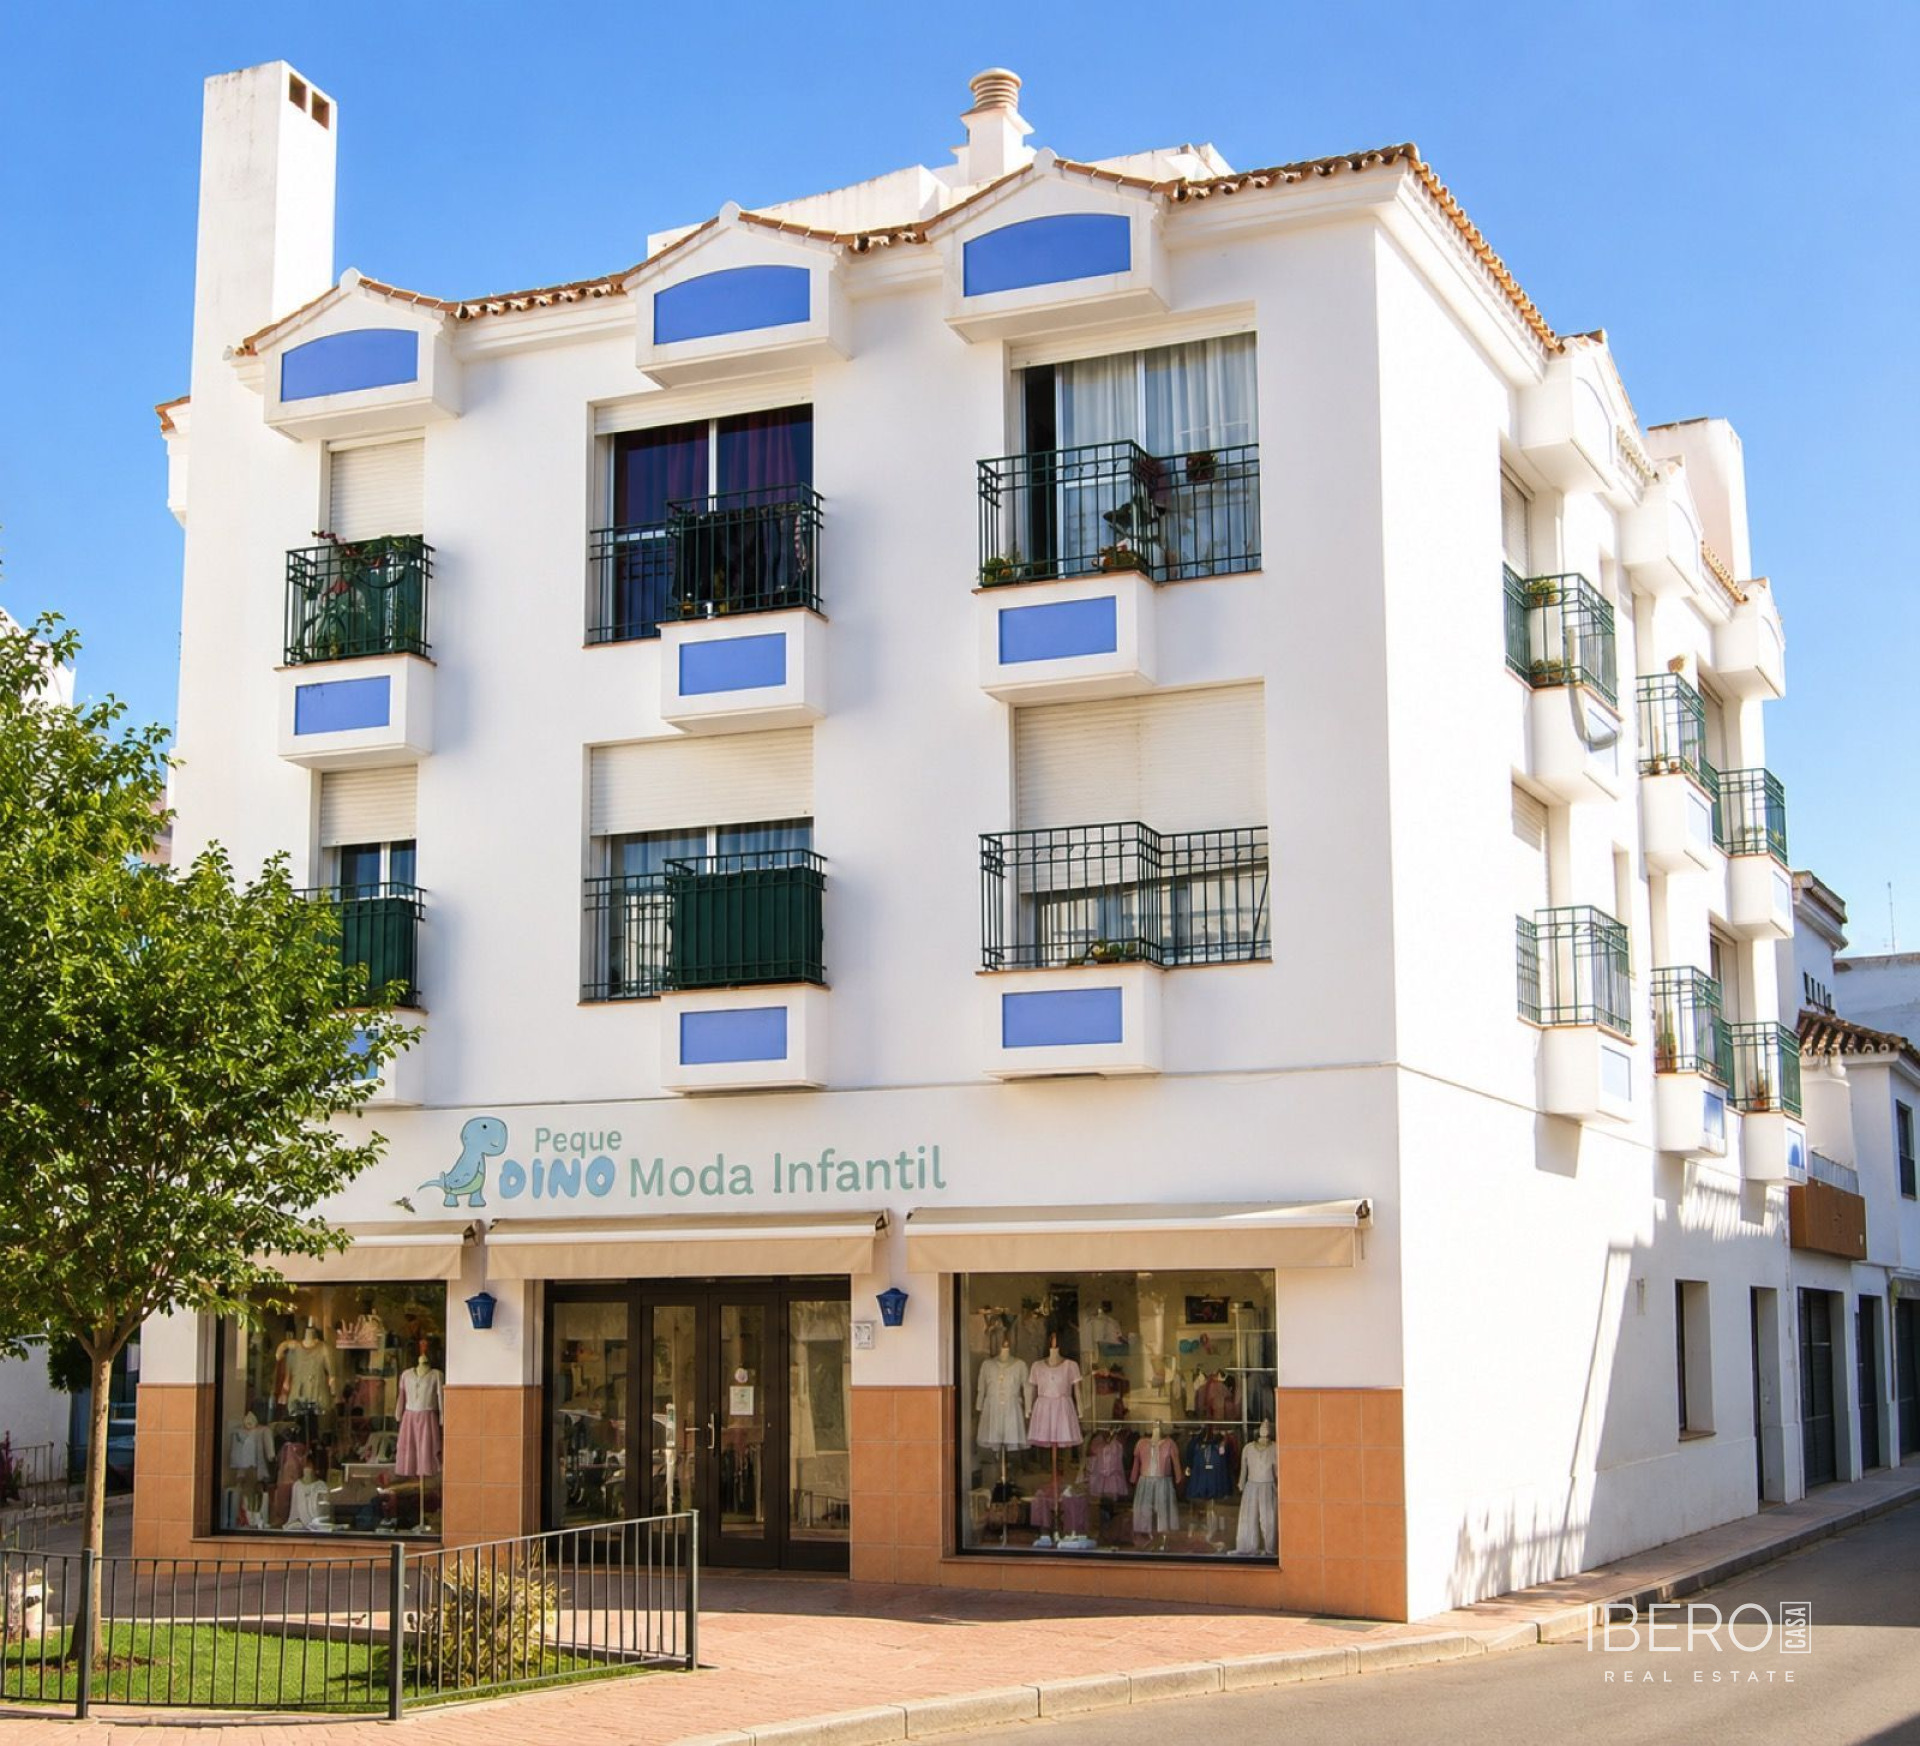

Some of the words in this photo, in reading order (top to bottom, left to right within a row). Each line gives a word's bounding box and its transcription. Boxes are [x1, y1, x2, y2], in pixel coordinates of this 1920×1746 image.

[534, 1127, 622, 1159] Peque
[499, 1155, 616, 1200] DINO
[630, 1152, 754, 1198] Moda
[773, 1145, 947, 1194] Infantil
